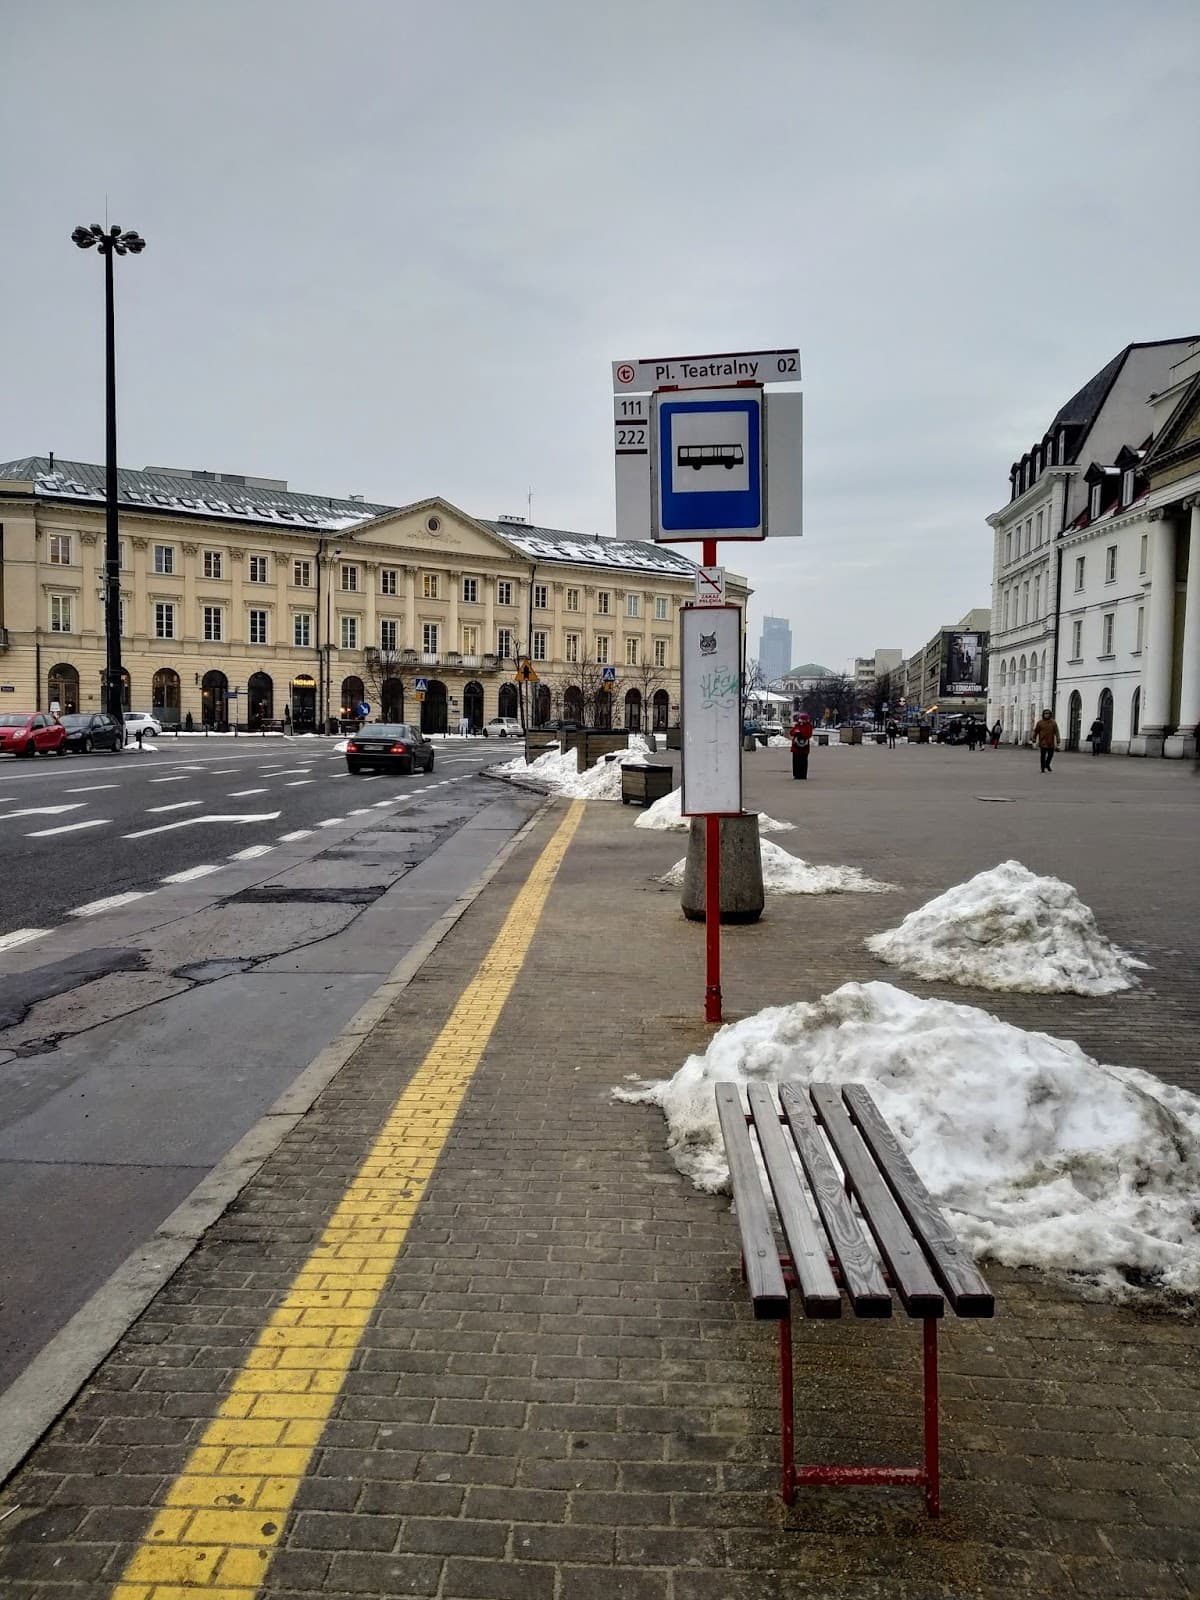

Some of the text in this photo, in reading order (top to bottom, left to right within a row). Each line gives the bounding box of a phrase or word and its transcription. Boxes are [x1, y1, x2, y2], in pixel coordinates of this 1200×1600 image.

[655, 358, 797, 380] Pl. Teatralny 02
[621, 400, 641, 415] 111
[618, 430, 645, 445] 222
